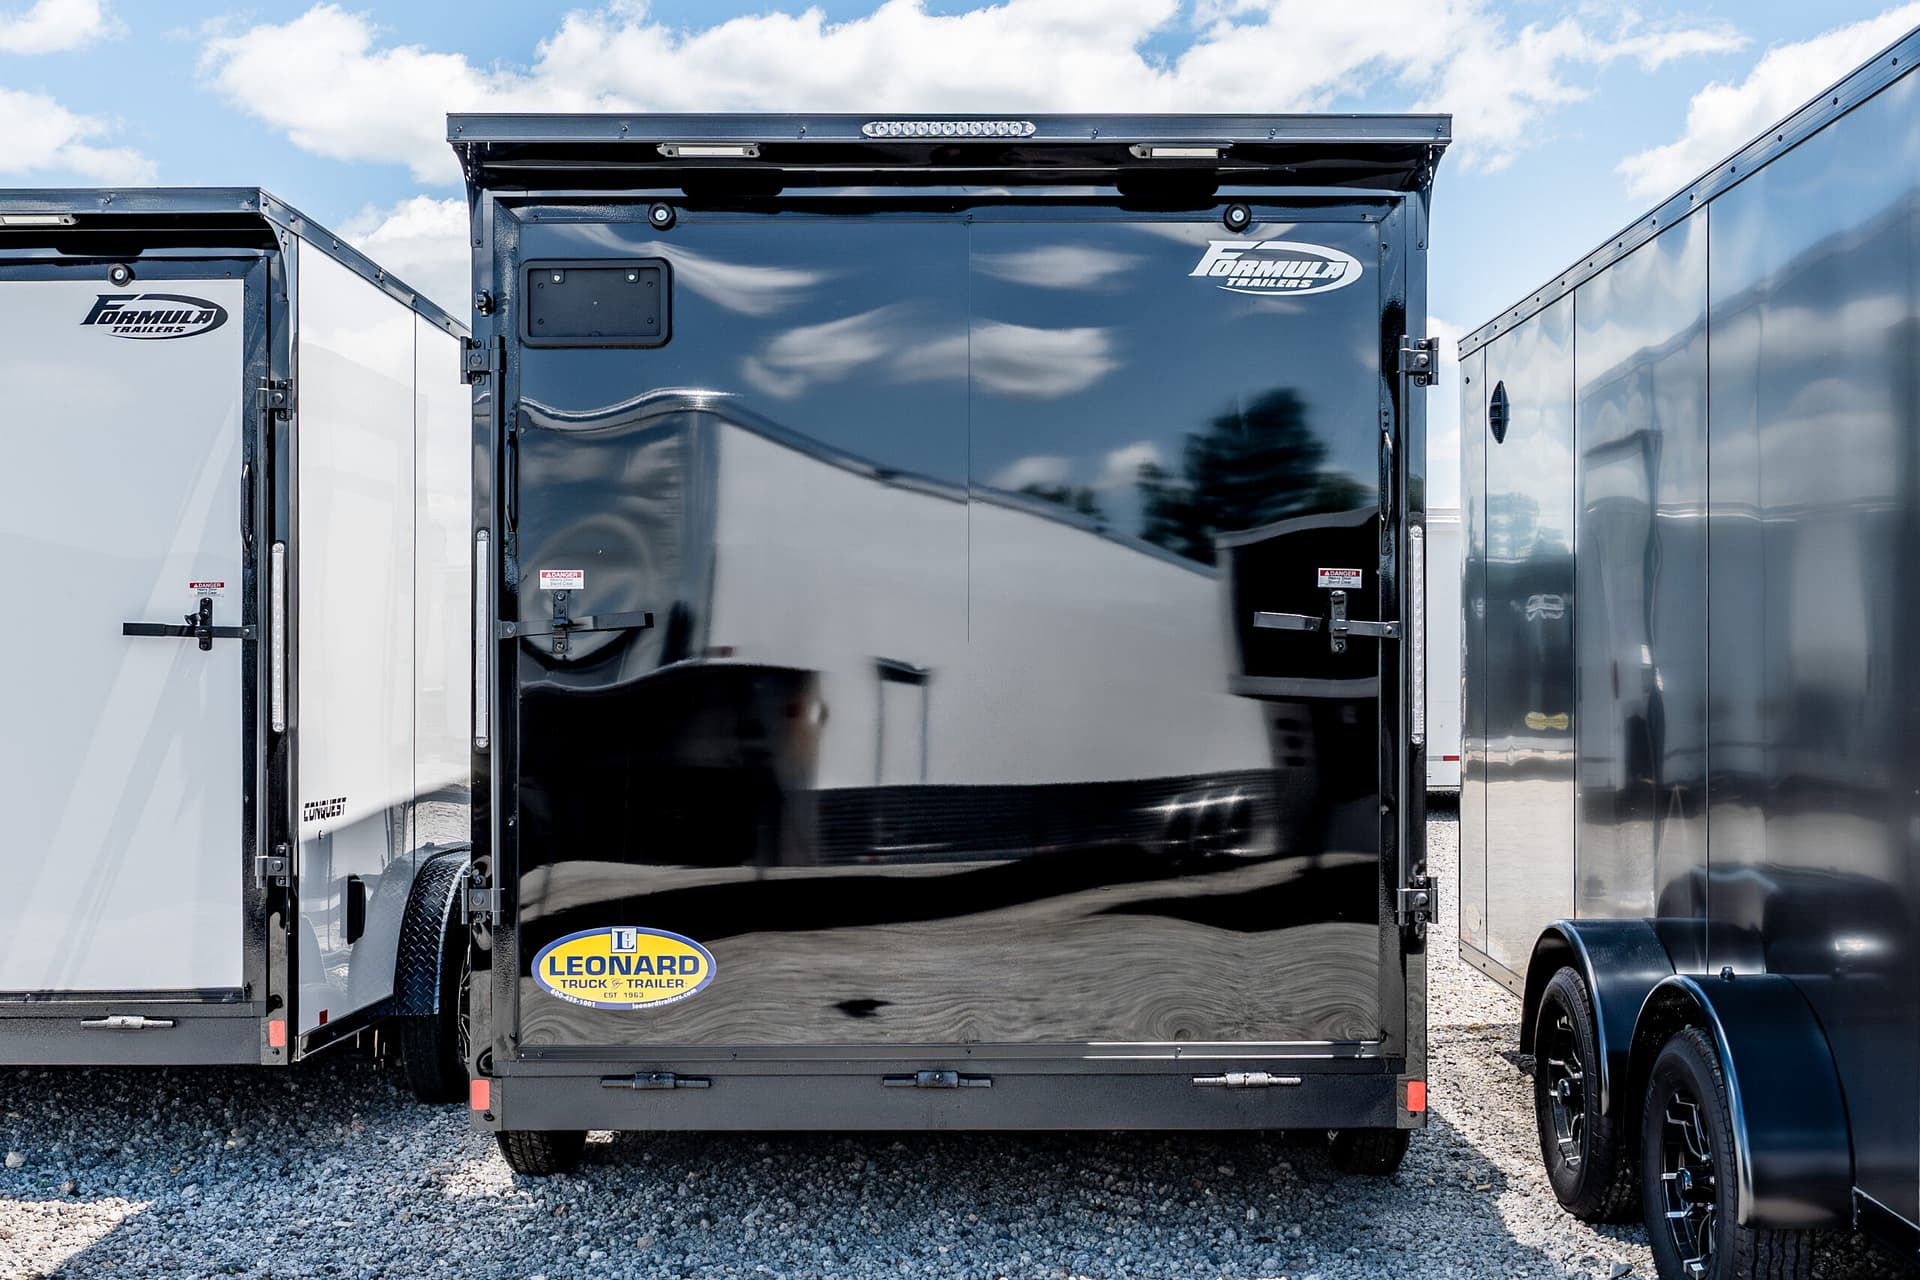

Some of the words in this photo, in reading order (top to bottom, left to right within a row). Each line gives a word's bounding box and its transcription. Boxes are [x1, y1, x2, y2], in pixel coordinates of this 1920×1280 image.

[1188, 240, 1348, 279] FORMULA
[1226, 277, 1313, 288] TRAILERS
[80, 294, 216, 326] FORMULA
[304, 797, 347, 822] CONQUEST
[550, 956, 700, 976] LEONARD
[560, 979, 607, 989] TRUCK
[627, 979, 685, 988] TRAILER
[632, 987, 698, 1010] leonardtrailers.com
